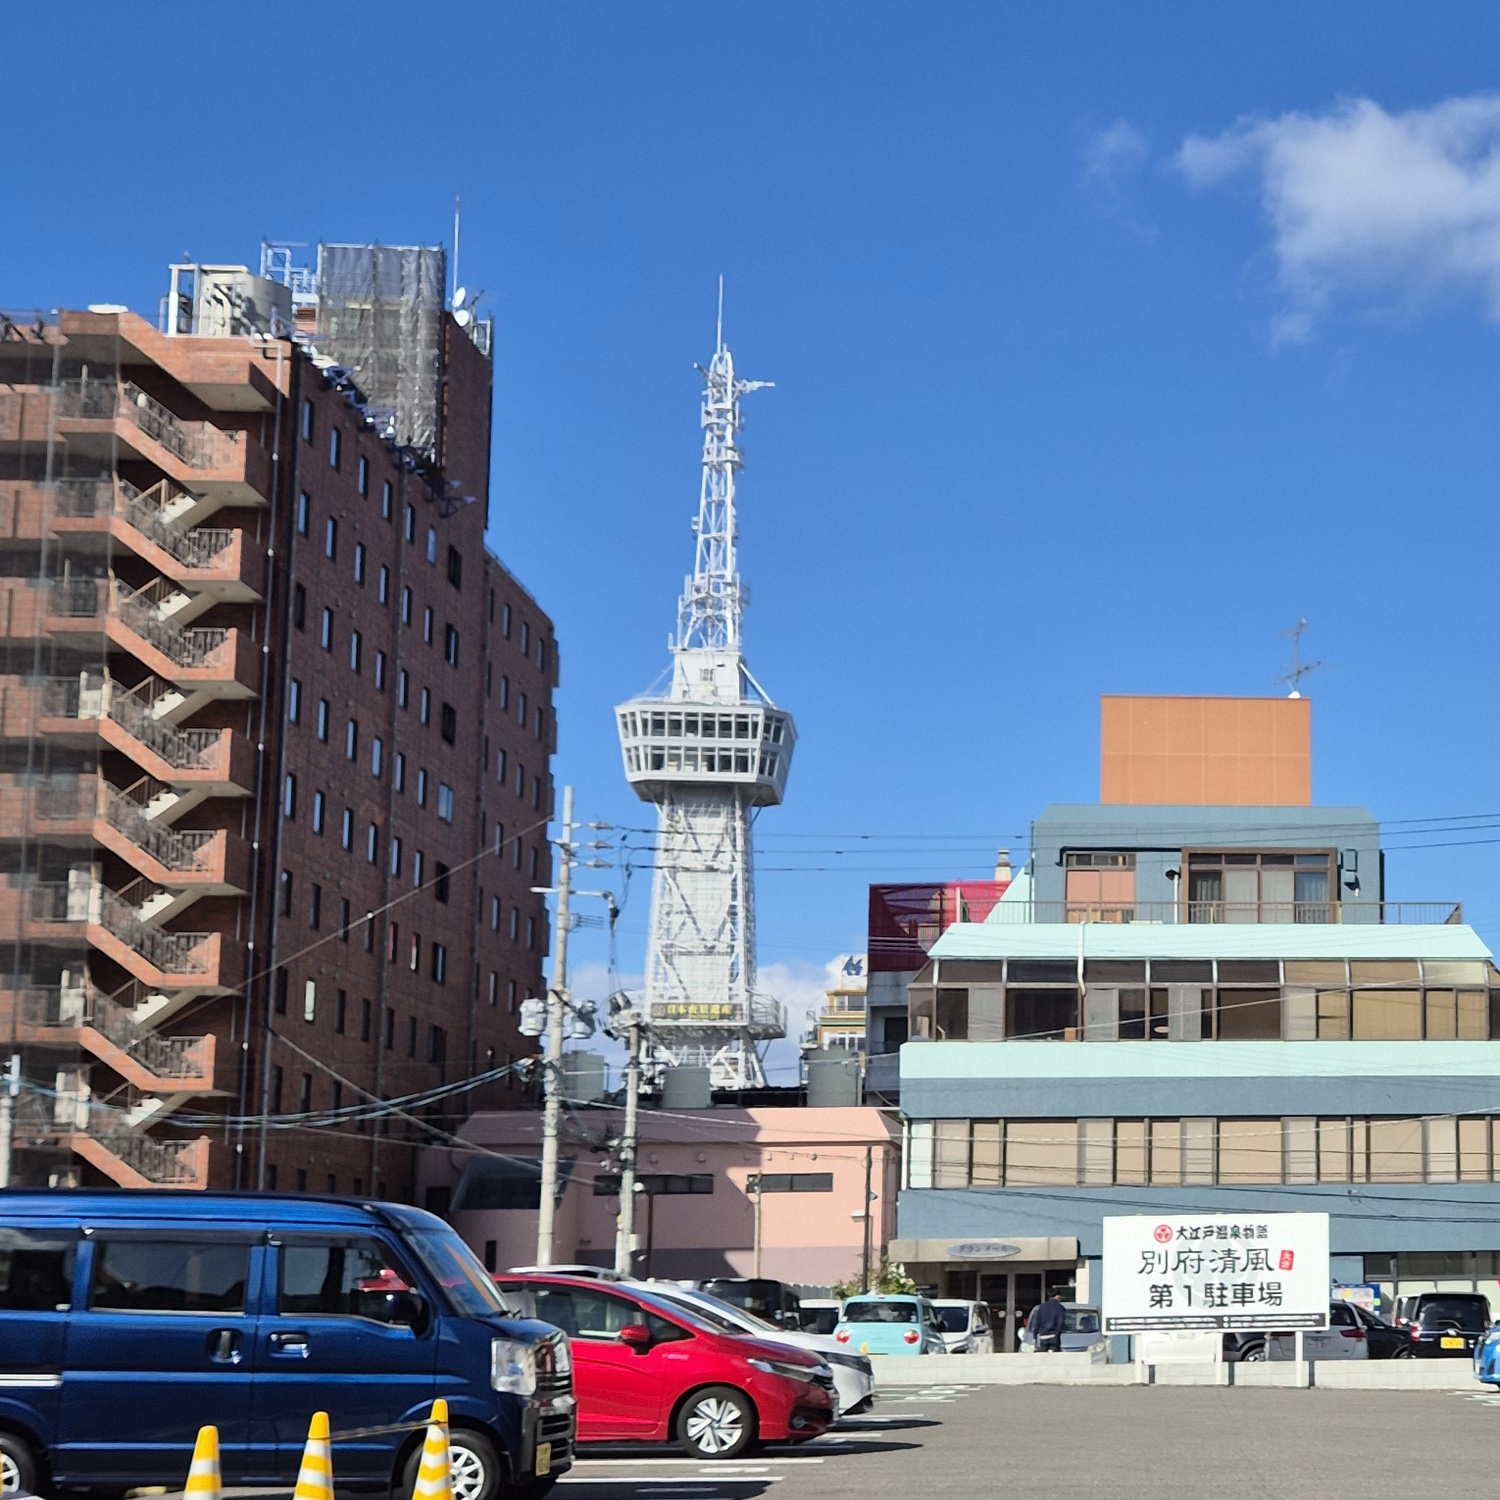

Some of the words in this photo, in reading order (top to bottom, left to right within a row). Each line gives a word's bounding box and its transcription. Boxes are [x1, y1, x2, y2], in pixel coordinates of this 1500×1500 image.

[1137, 1247, 1275, 1275] 別府清風
[1149, 1282, 1283, 1309] 第1駐車場
